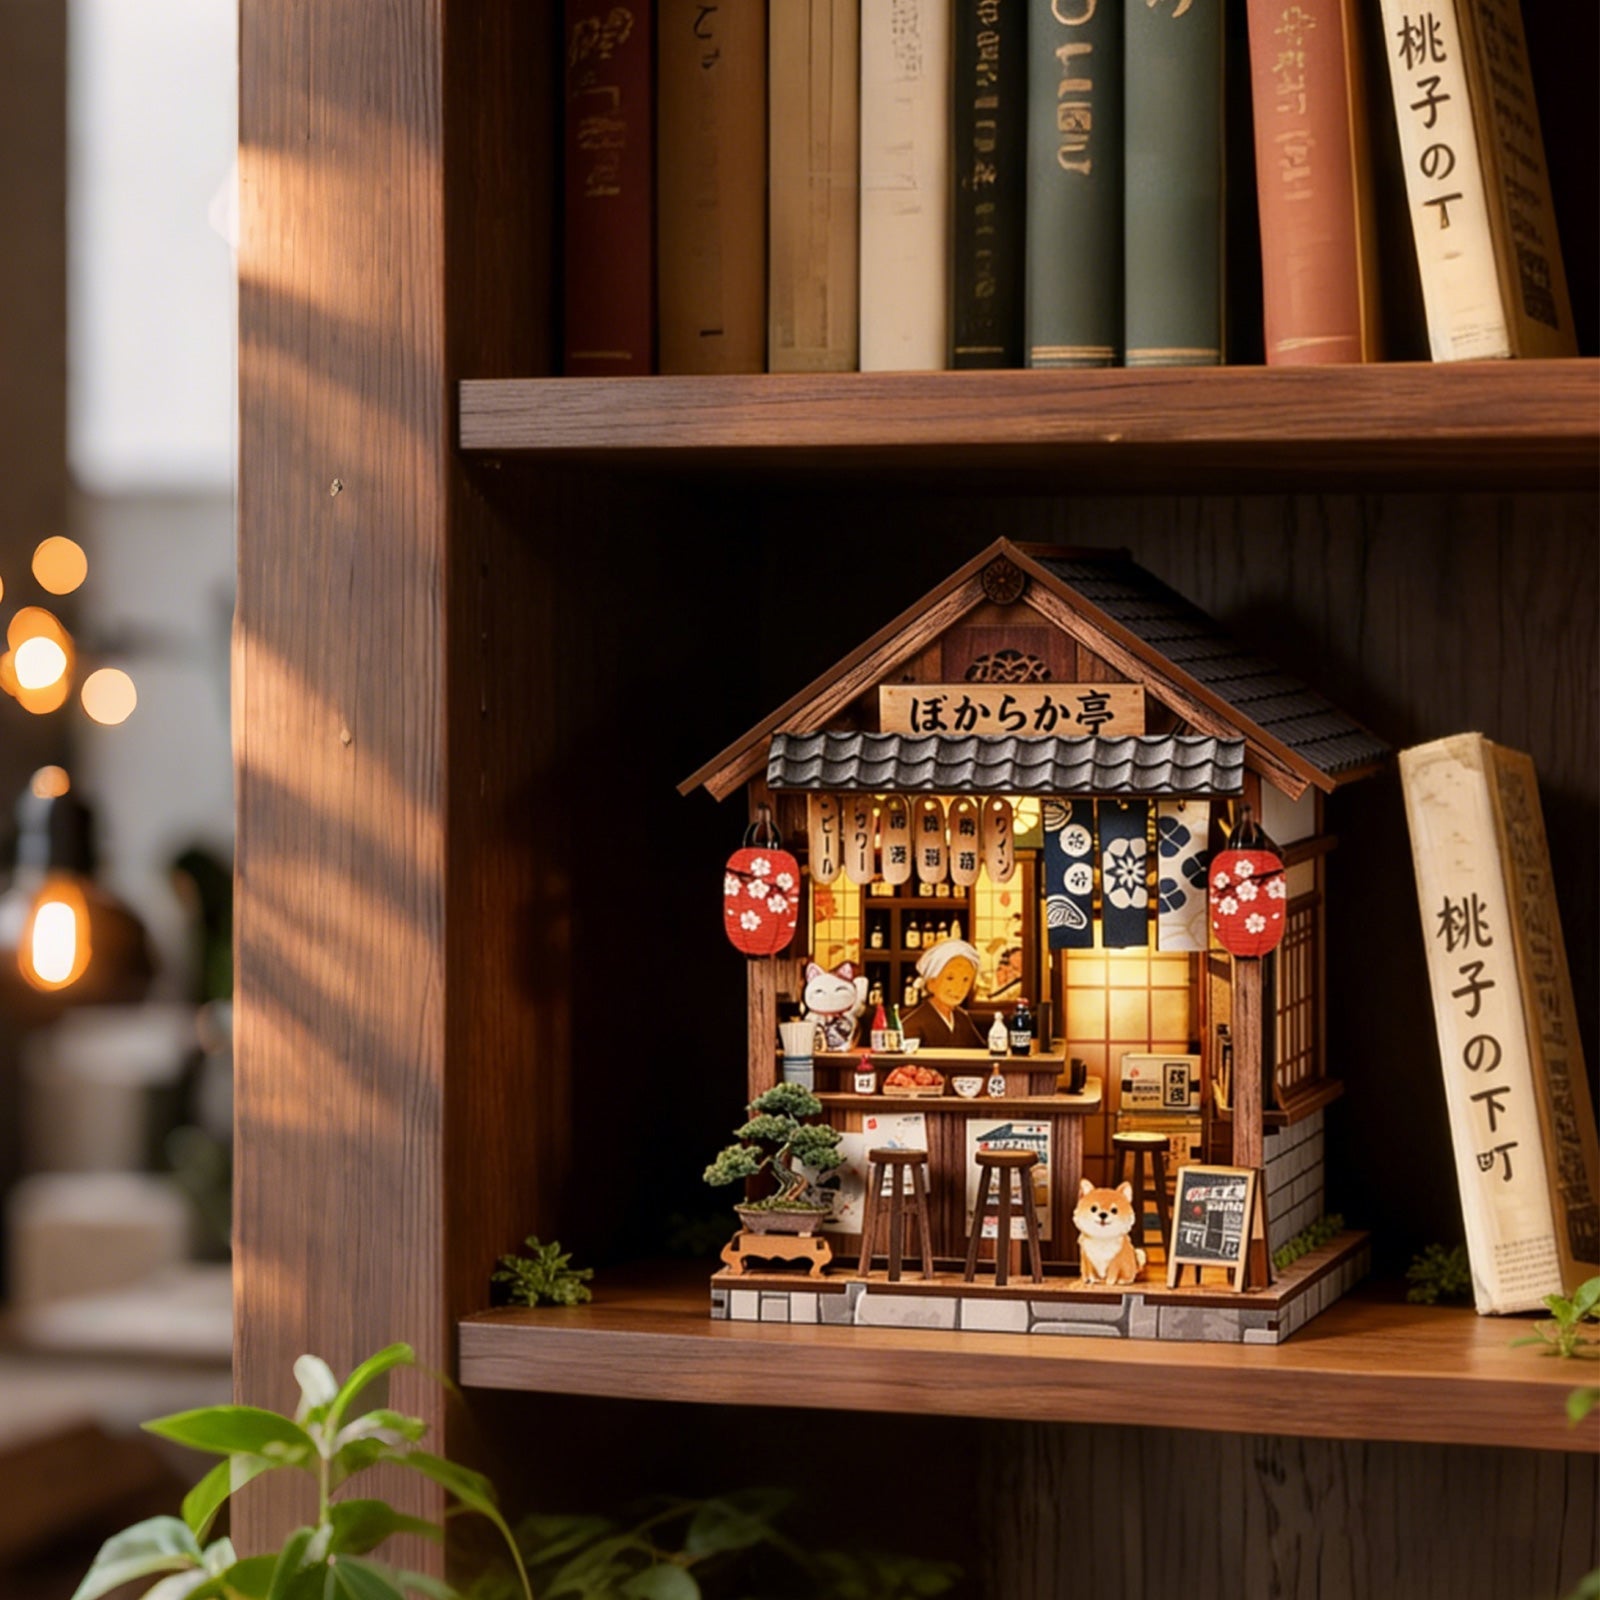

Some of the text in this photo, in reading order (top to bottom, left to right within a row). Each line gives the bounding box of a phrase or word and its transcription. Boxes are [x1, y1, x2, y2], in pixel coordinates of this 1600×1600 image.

[1436, 892, 1519, 1183] 桃子の下町
